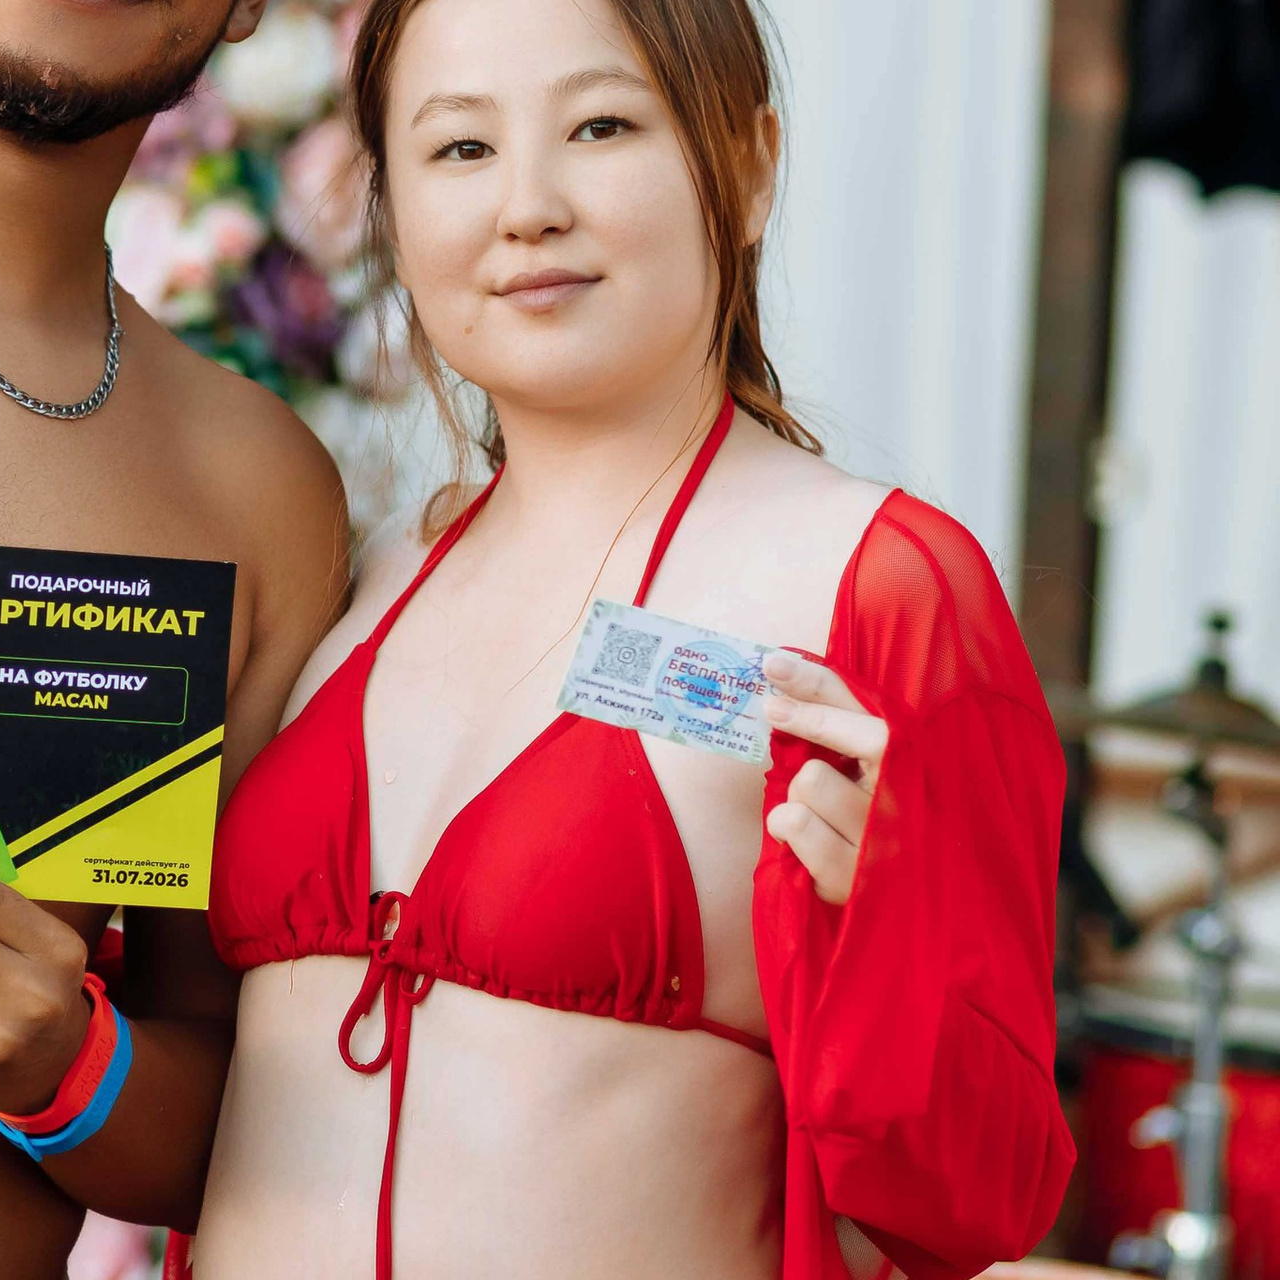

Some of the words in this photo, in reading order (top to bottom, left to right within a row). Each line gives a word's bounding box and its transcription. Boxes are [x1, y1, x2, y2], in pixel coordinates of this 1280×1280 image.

[10, 574, 151, 596] ПОДАРОЧНЫЙ
[674, 646, 709, 662] одно
[0, 667, 29, 685] НА
[34, 669, 148, 691] ФУТБОЛКУ
[668, 658, 767, 696] БЕСПЛАТНОЕ
[662, 675, 739, 705] посещение
[34, 691, 109, 710] MACAN
[84, 857, 133, 866] сертификат
[135, 860, 177, 869] действует
[91, 869, 189, 888] 31.07.2026
